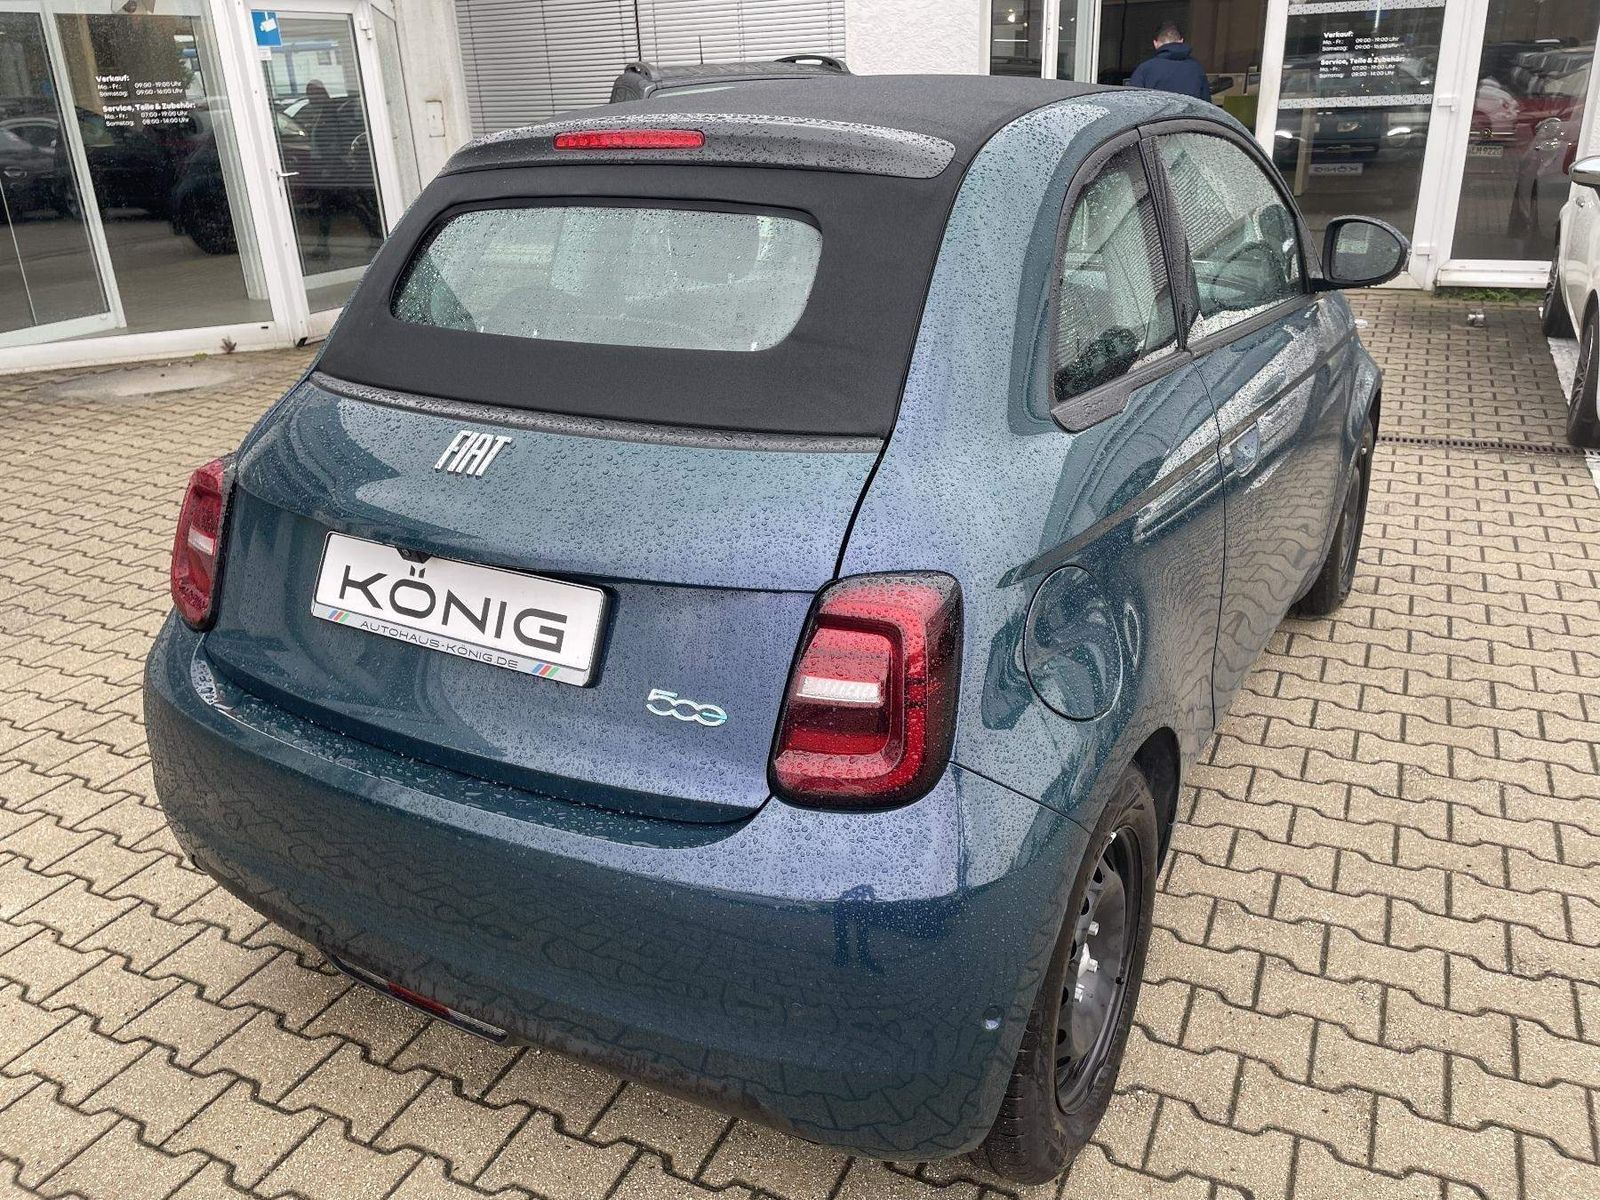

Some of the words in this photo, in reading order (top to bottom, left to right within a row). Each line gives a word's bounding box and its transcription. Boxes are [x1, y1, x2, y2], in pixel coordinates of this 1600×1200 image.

[96, 74, 129, 82] Verkauf:
[135, 103, 154, 111] Teile
[434, 430, 513, 477] FIAT
[338, 564, 568, 653] KÖNIG
[360, 620, 519, 669] AUTOHAUS-KÖNIG.DE
[646, 688, 728, 727] 500
